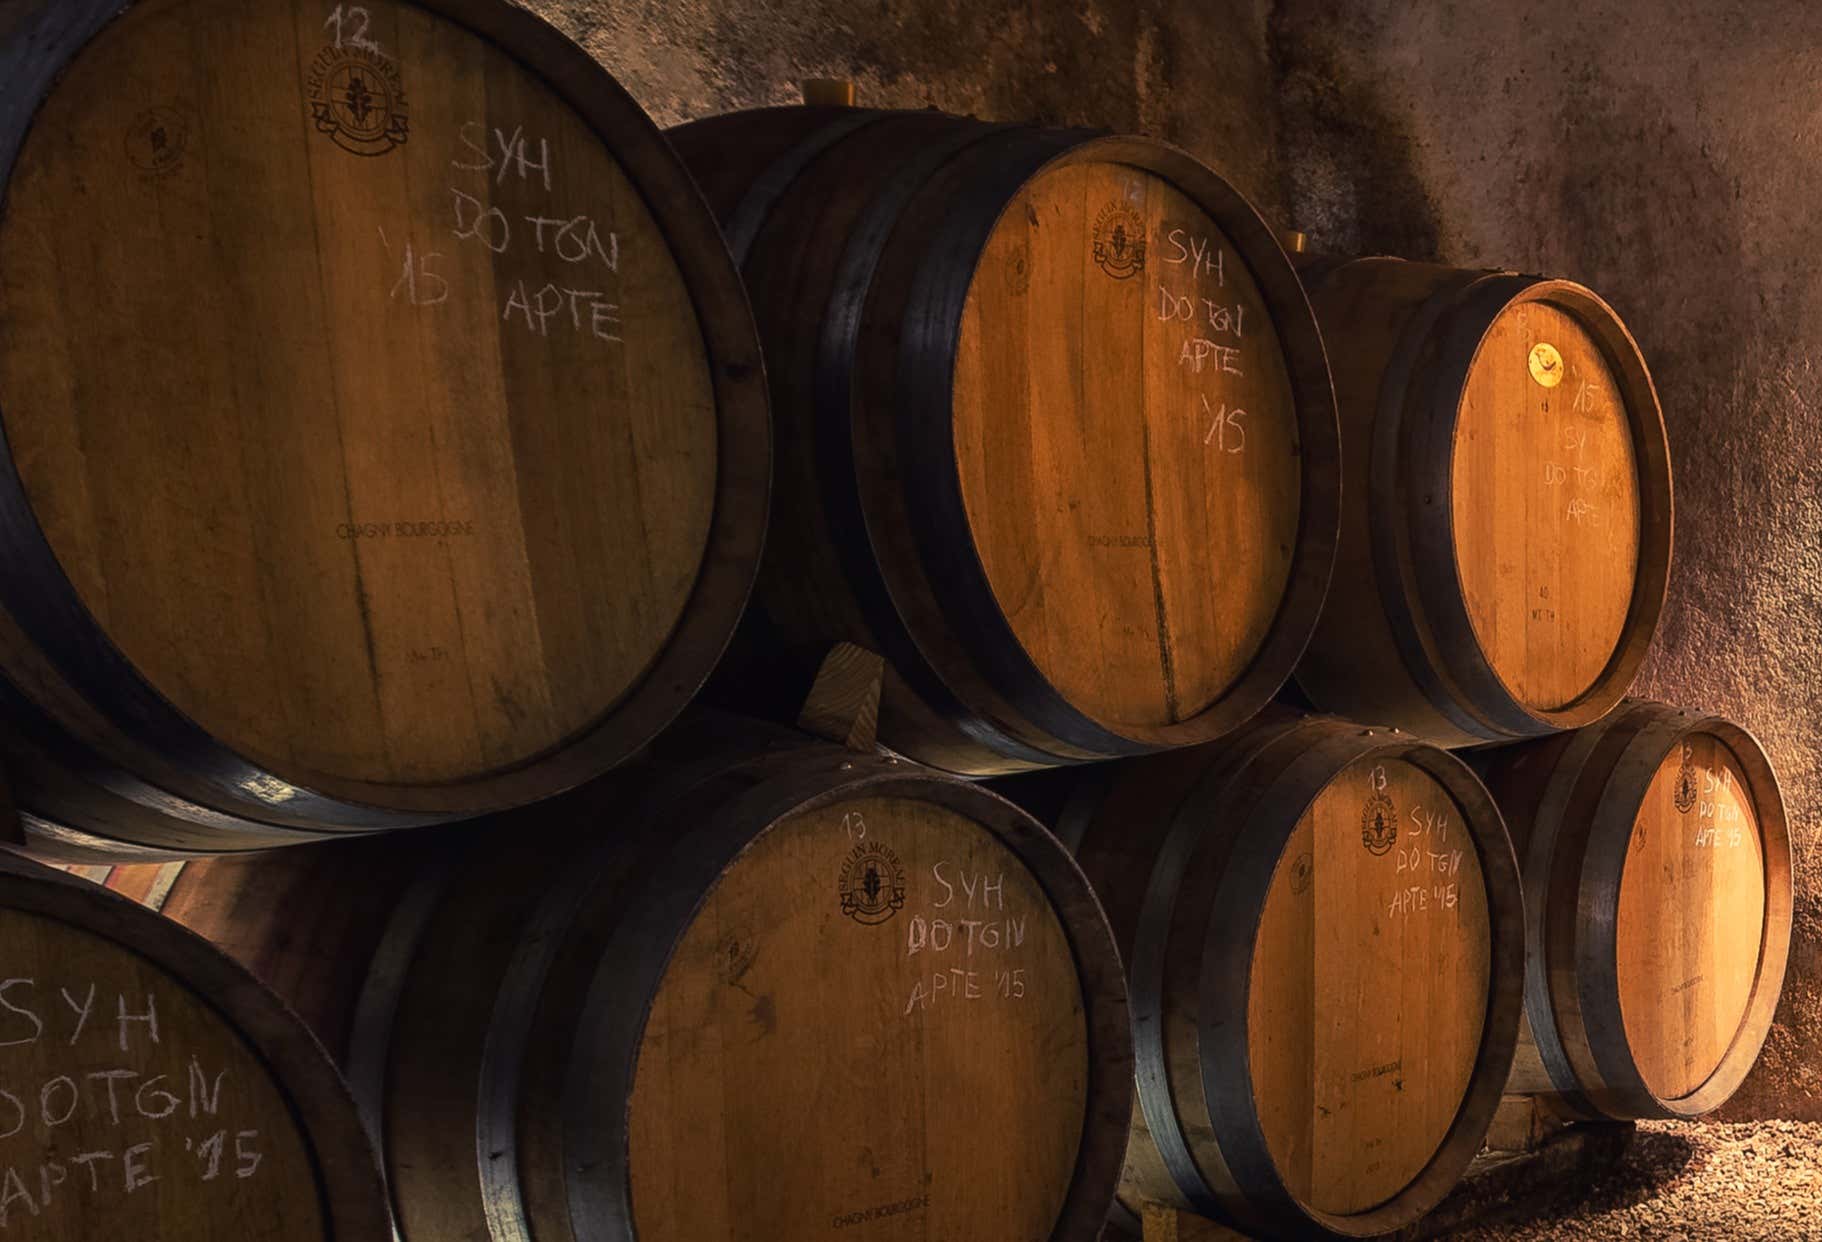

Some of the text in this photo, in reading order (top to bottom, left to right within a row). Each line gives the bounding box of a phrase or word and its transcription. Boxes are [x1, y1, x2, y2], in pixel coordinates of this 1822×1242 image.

[323, 3, 380, 50] 12
[452, 121, 550, 192] SYH
[1163, 229, 1223, 287] SYH
[504, 280, 624, 342] APTE
[1158, 286, 1193, 321] DO
[1178, 338, 1243, 376] APTE
[1367, 765, 1388, 791] 13
[841, 811, 866, 840] 13
[1408, 806, 1448, 842] SYH
[933, 861, 1003, 911] SYH
[1387, 886, 1428, 919] APTE
[0, 978, 159, 1051] SYH
[904, 968, 982, 1015] APTE
[0, 1142, 162, 1228] APTE
